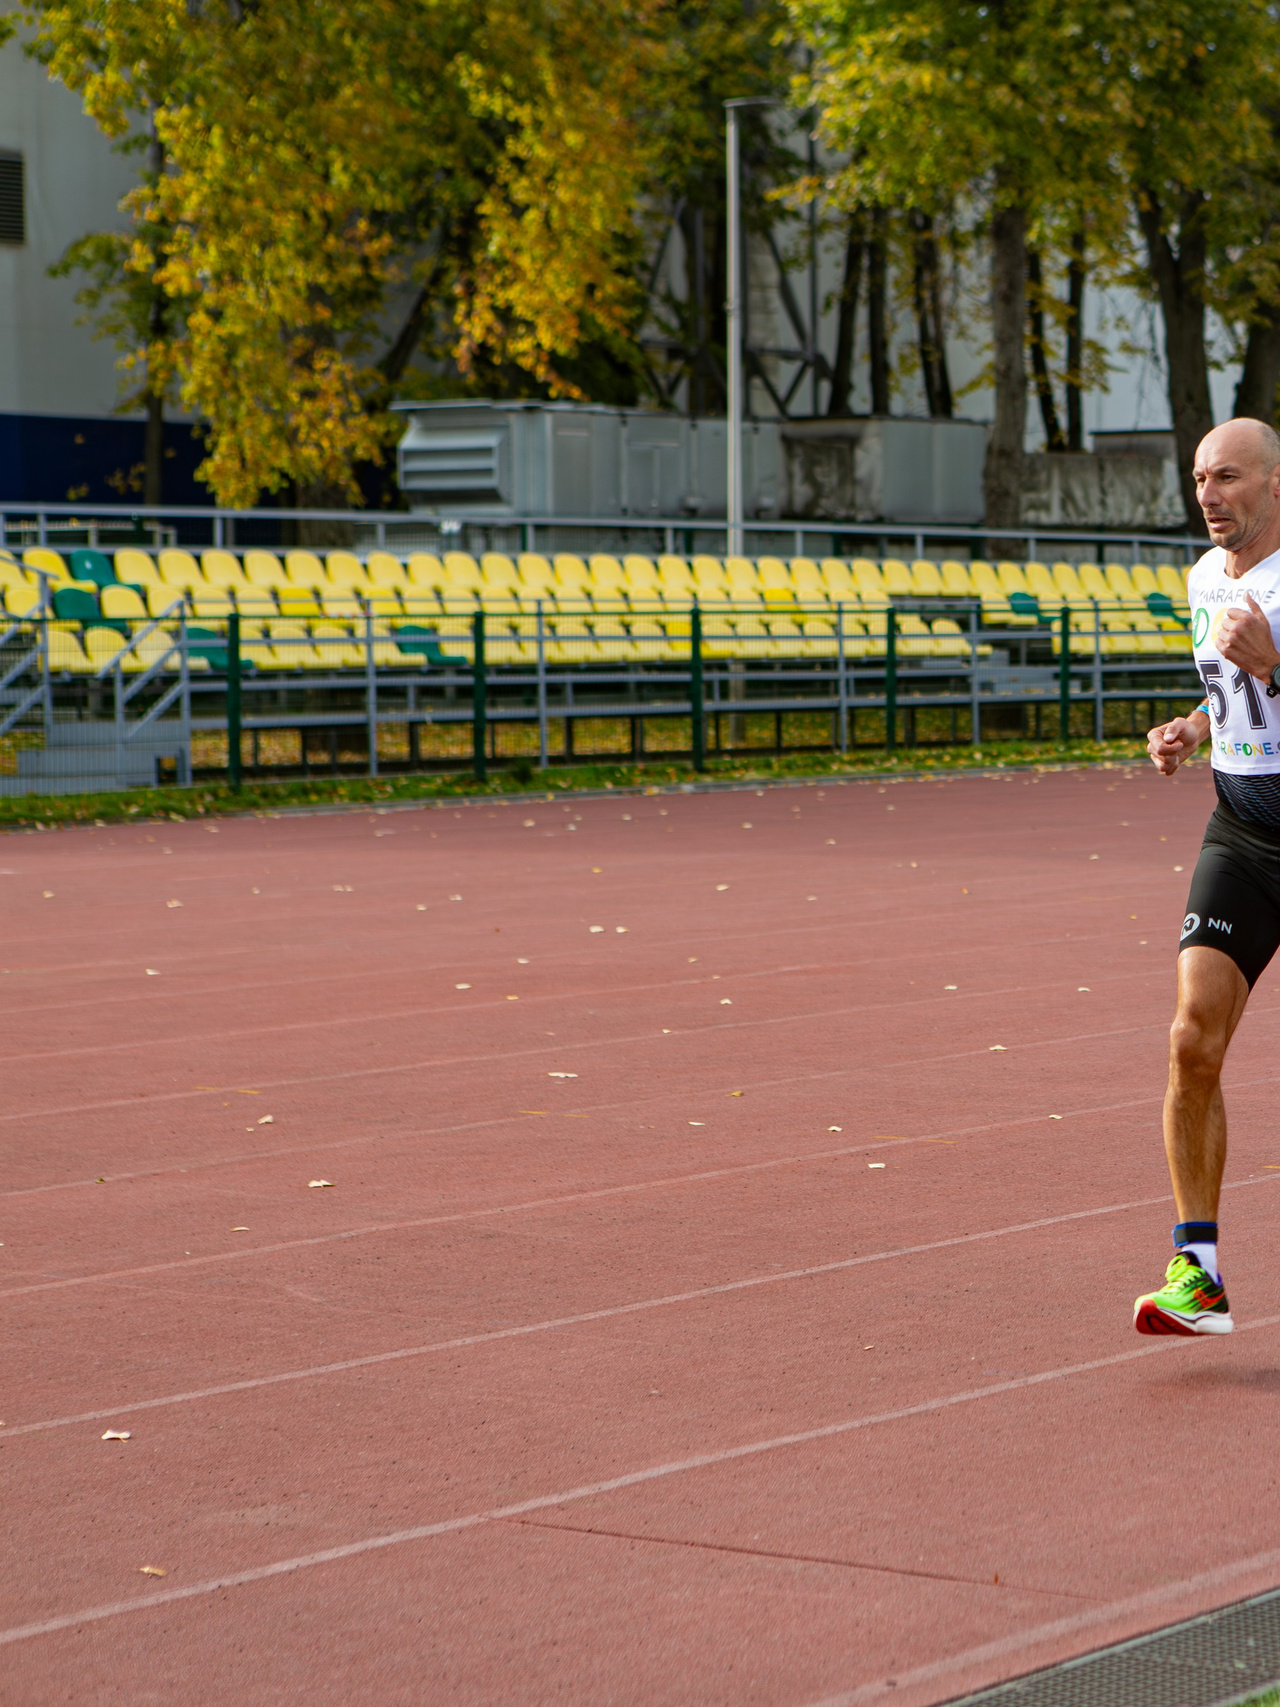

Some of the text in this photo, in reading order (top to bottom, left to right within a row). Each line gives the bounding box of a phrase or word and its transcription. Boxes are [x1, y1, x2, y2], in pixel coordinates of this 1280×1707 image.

[1199, 588, 1276, 604] MARAFONE
[1199, 659, 1267, 730] 51
[1207, 917, 1233, 935] NN
